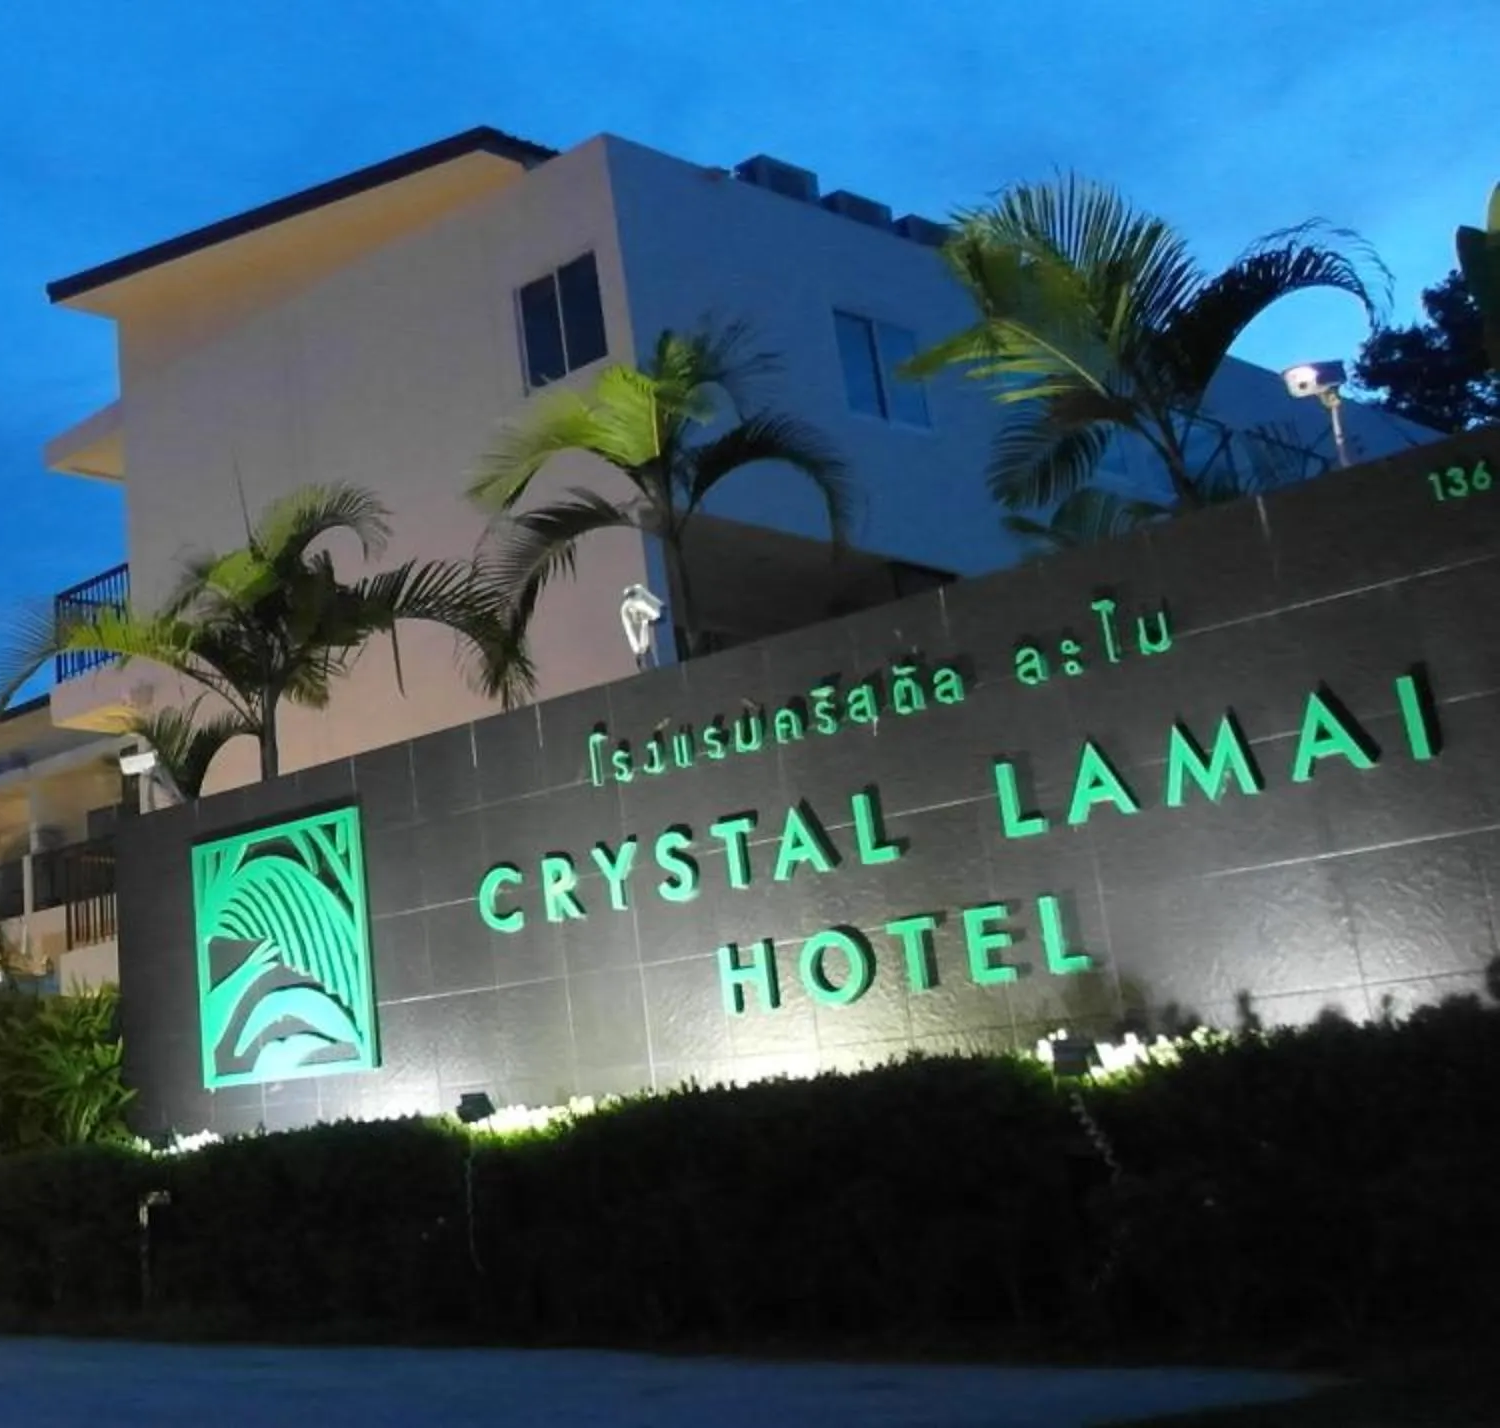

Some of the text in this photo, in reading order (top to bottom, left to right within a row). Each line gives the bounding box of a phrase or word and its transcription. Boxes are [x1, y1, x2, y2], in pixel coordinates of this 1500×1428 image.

[1427, 460, 1493, 502] 136
[476, 674, 1437, 935] CRYSTAL LAMAI
[718, 894, 1095, 1016] HOTEL
